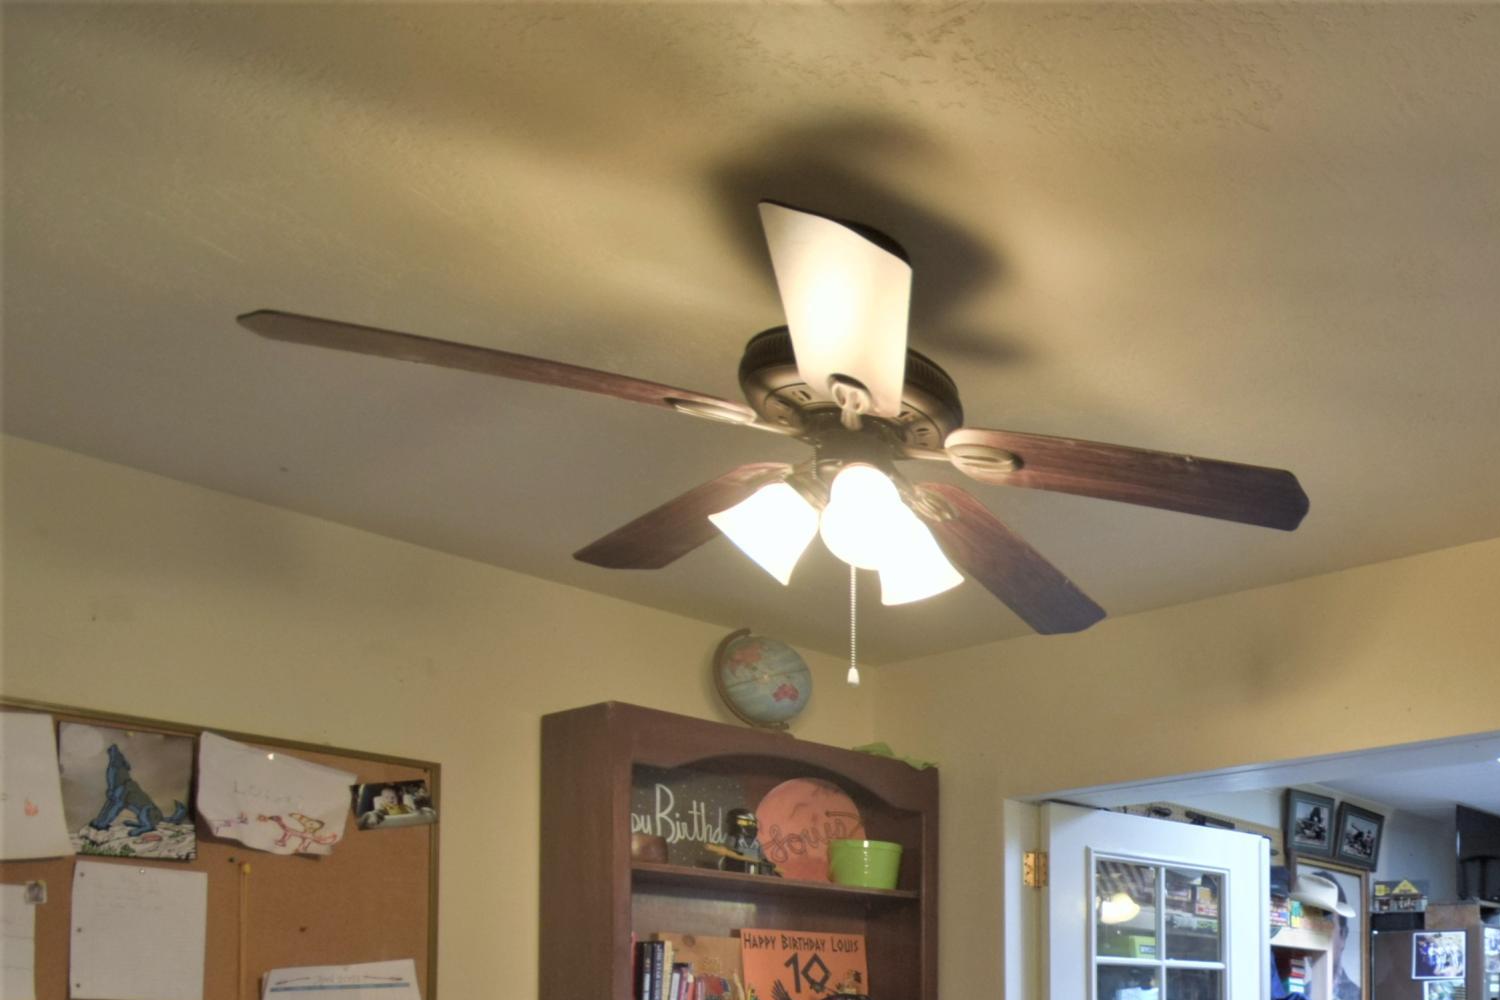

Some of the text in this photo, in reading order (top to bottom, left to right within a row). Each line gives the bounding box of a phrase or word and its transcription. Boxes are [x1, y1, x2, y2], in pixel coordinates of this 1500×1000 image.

[655, 783, 729, 844] Birthd
[743, 932, 859, 953] HAPPY BIRTHDAY LOUIS
[784, 952, 832, 994] 10
